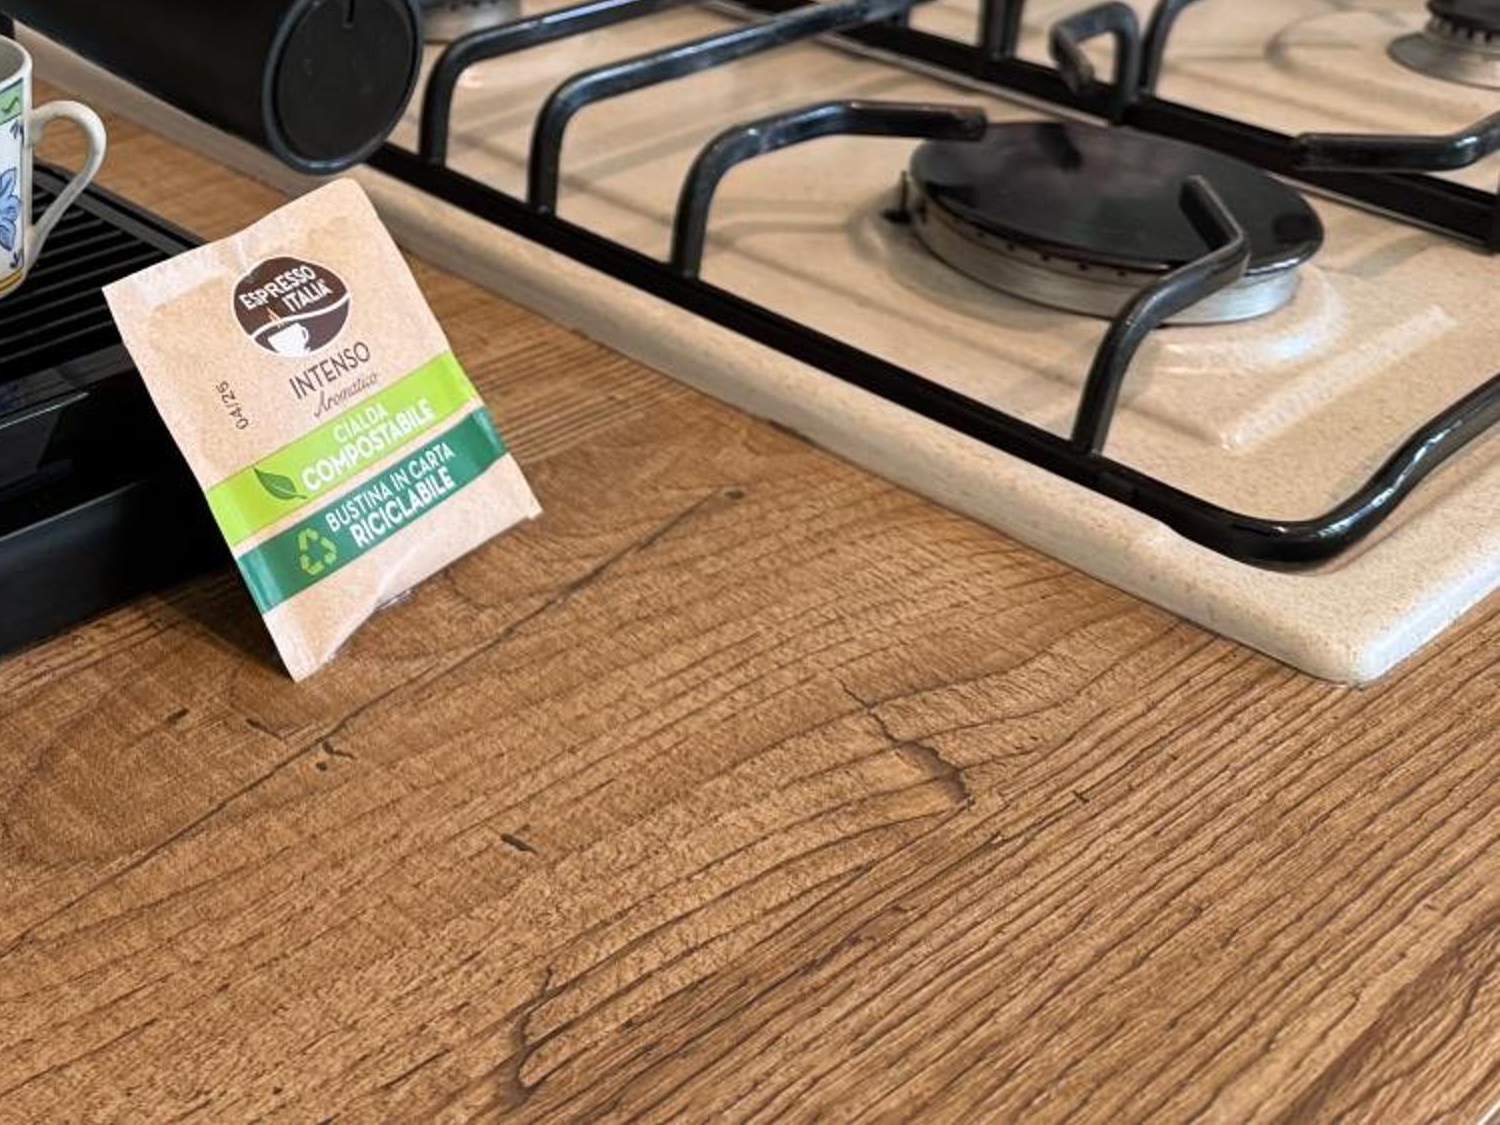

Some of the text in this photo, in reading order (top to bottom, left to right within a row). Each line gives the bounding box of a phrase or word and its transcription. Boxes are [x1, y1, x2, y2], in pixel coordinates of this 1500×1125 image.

[238, 265, 317, 310] ESPRESSO
[289, 341, 371, 400] INTENSO
[313, 372, 379, 418] Aromatico
[302, 398, 436, 492] COMPOSTABILE
[332, 402, 390, 444] CIALDA
[325, 442, 455, 533] BUSTINA IN CARTA
[350, 466, 456, 549] RICICLABILE
